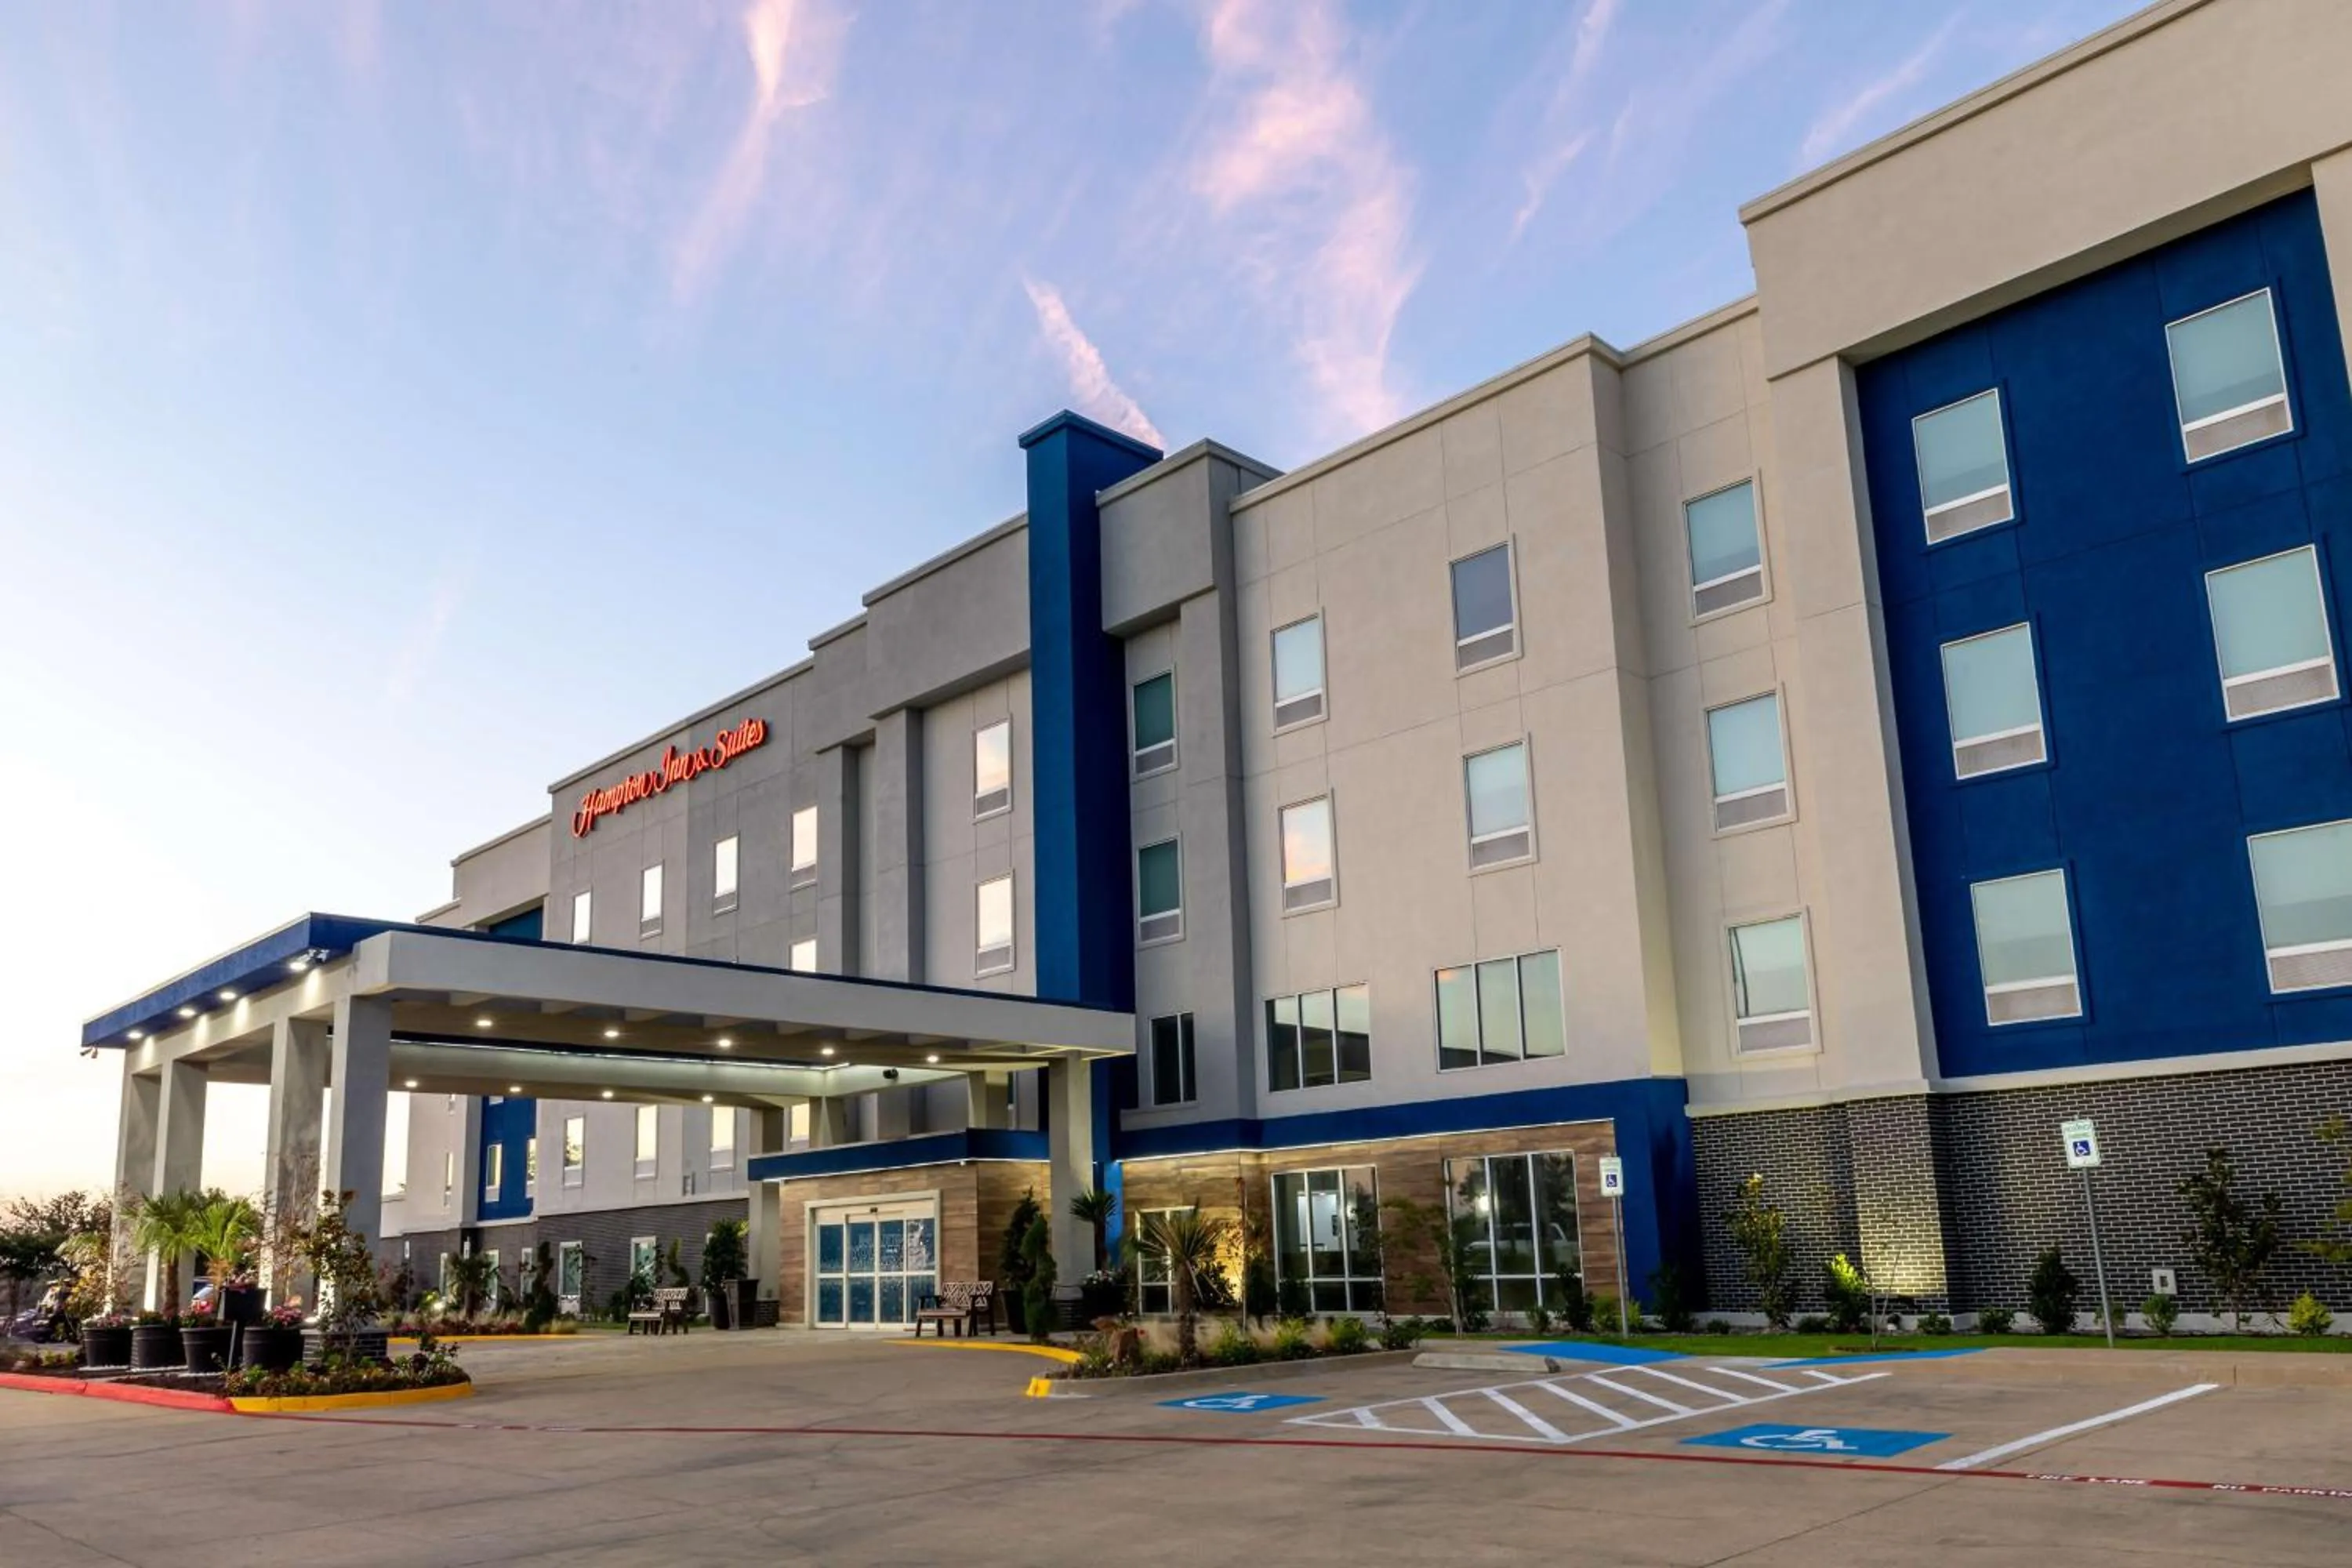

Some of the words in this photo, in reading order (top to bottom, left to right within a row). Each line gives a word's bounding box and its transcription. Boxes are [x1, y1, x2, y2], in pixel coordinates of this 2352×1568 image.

[572, 771, 654, 837] Hampton
[653, 746, 697, 793] Inn
[710, 717, 768, 769] Suites
